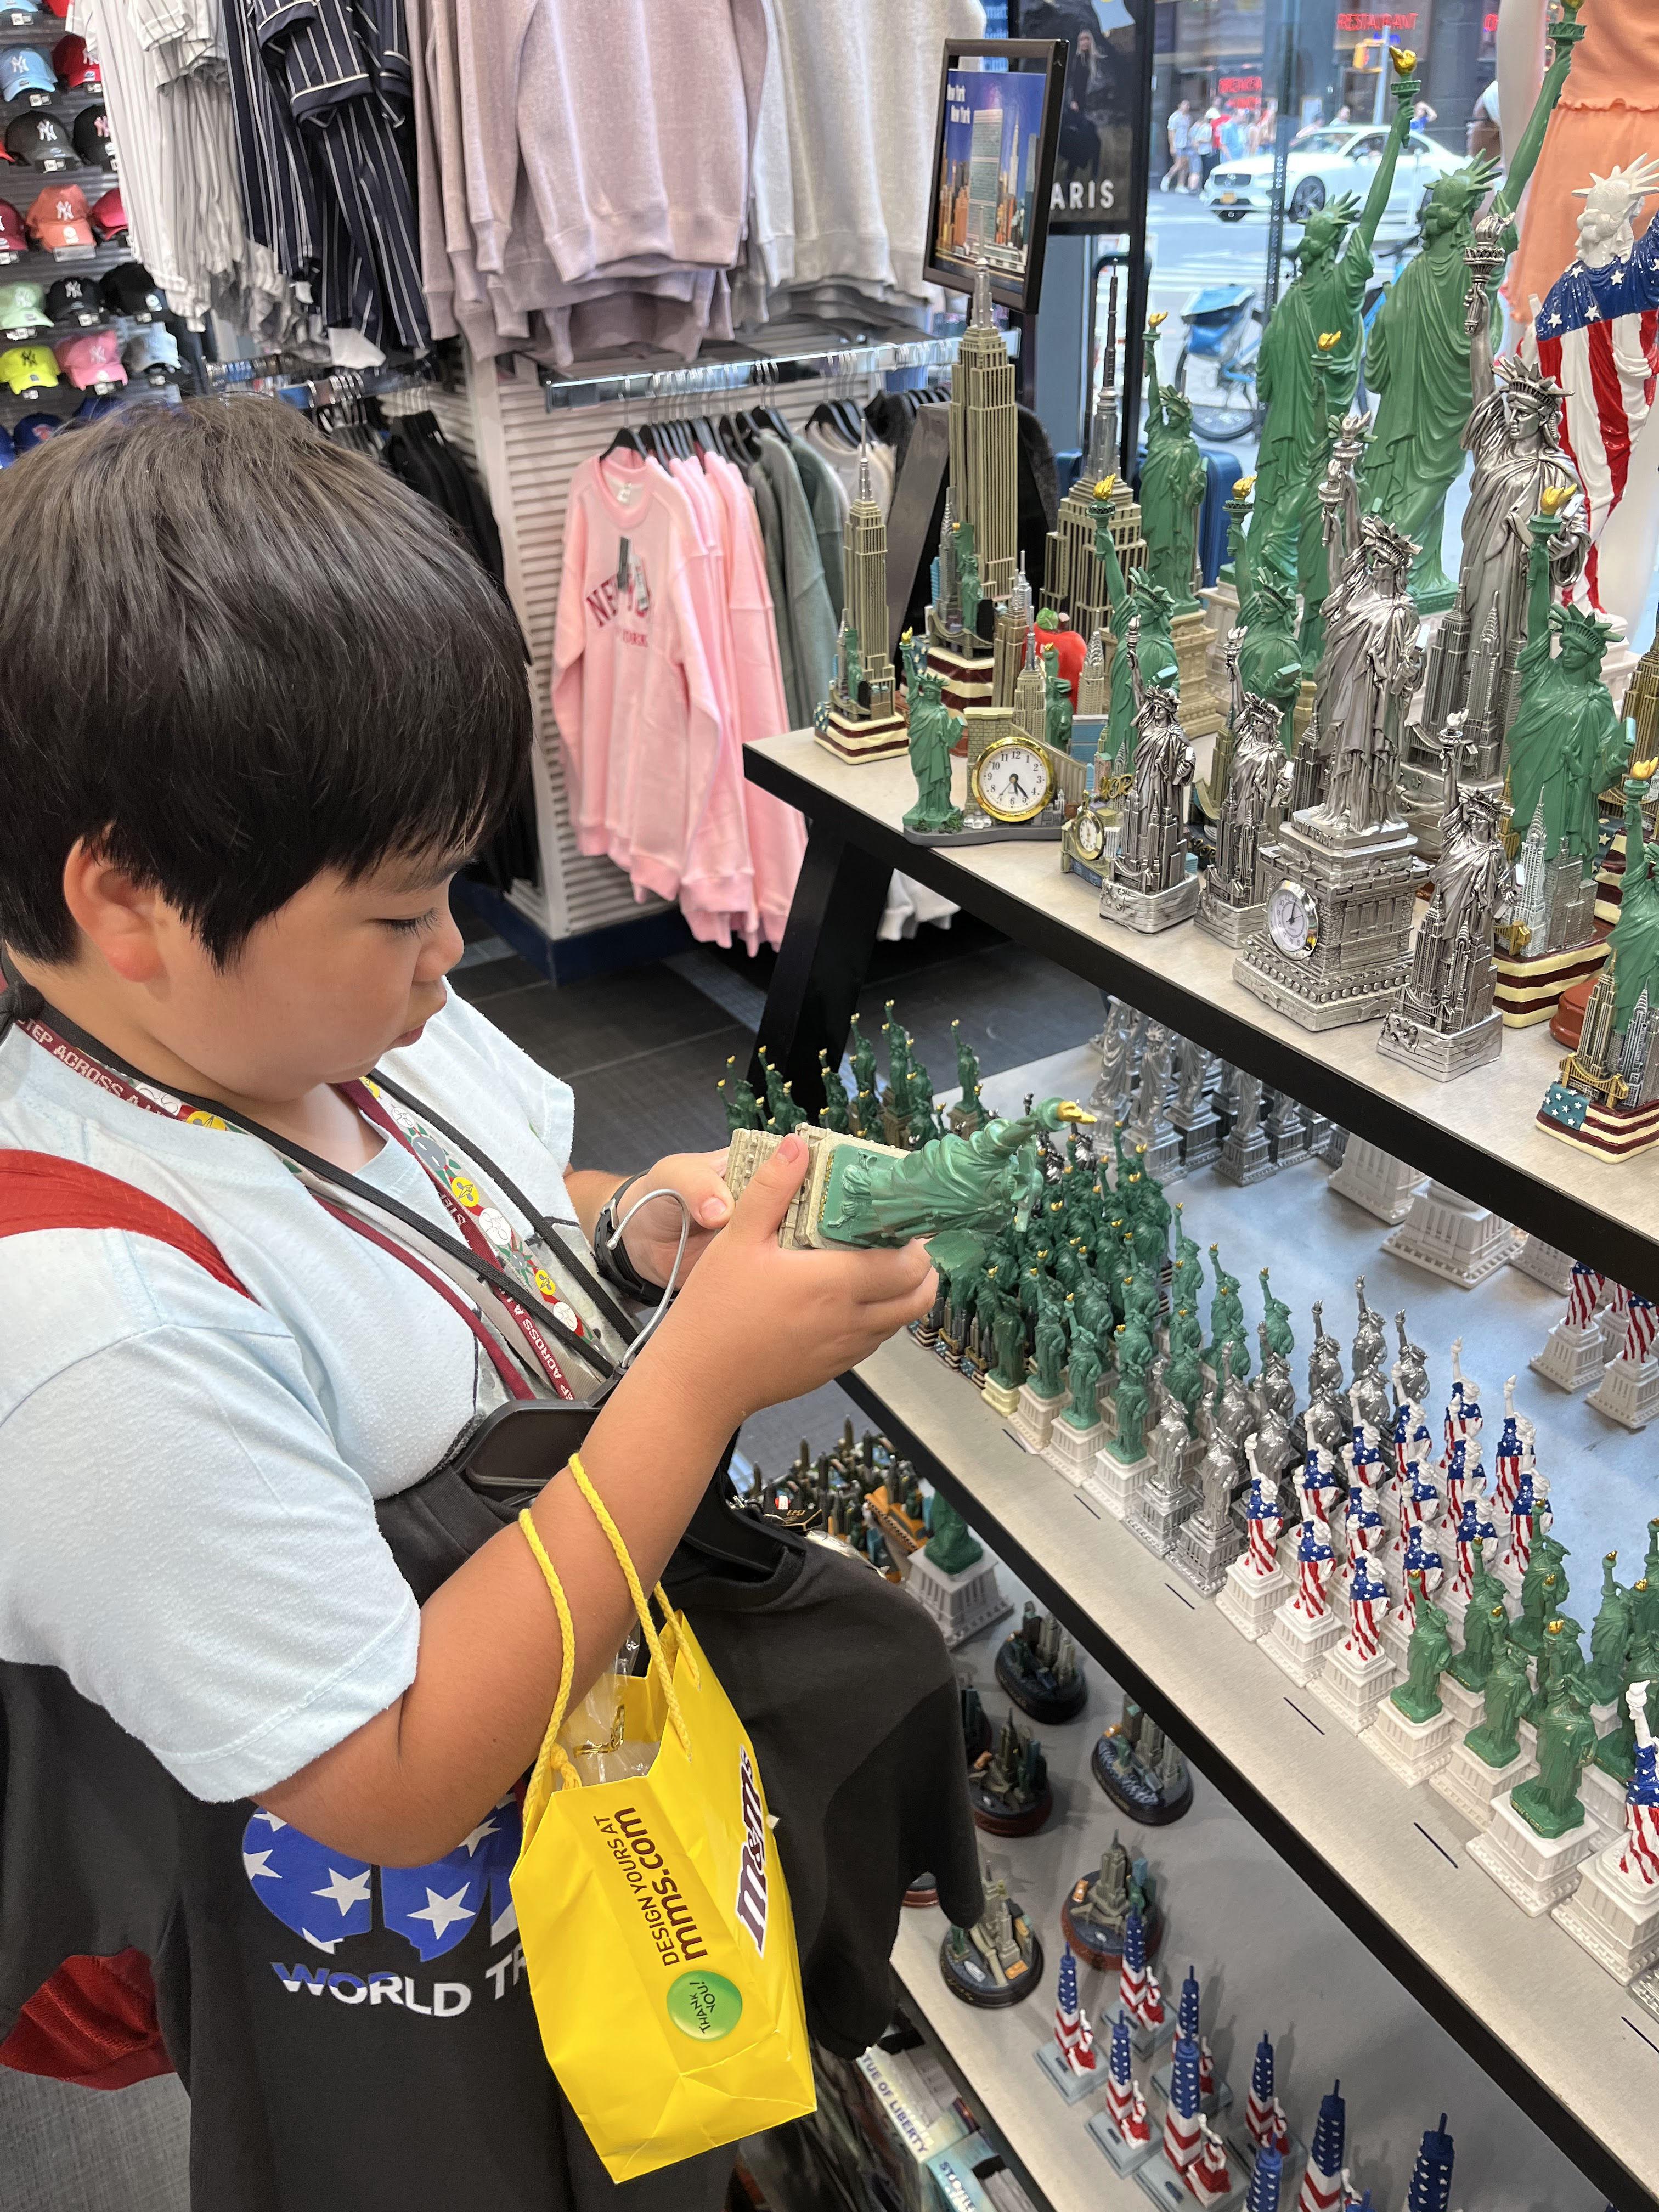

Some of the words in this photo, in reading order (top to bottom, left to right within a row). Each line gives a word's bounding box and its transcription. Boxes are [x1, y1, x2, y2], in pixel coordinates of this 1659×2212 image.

[1337, 13, 1418, 31] RESTAURANT
[37, 119, 58, 142] NY
[56, 201, 74, 221] NY
[65, 281, 82, 298] NY
[1001, 753, 1008, 762] 11
[1011, 751, 1021, 759] 12
[1026, 754, 1030, 763] 1
[992, 761, 1000, 770] 10
[1033, 763, 1039, 772] 2
[990, 784, 995, 793] 8
[1036, 776, 1042, 784] 3
[1031, 787, 1036, 795] 4
[53, 1045, 124, 1097] ACROSS
[522, 1318, 562, 1379] ACROSS
[592, 1815, 618, 1834] AT
[607, 1838, 648, 1894] YOURS
[614, 1807, 708, 1961] mms.com
[637, 1896, 680, 1966] DESIGN
[270, 1962, 472, 2018] WORLD
[689, 1981, 716, 2013] YOU!
[689, 1993, 711, 2034] THANK
[878, 2082, 893, 2097] OF
[889, 2099, 929, 2154] LIBERTY
